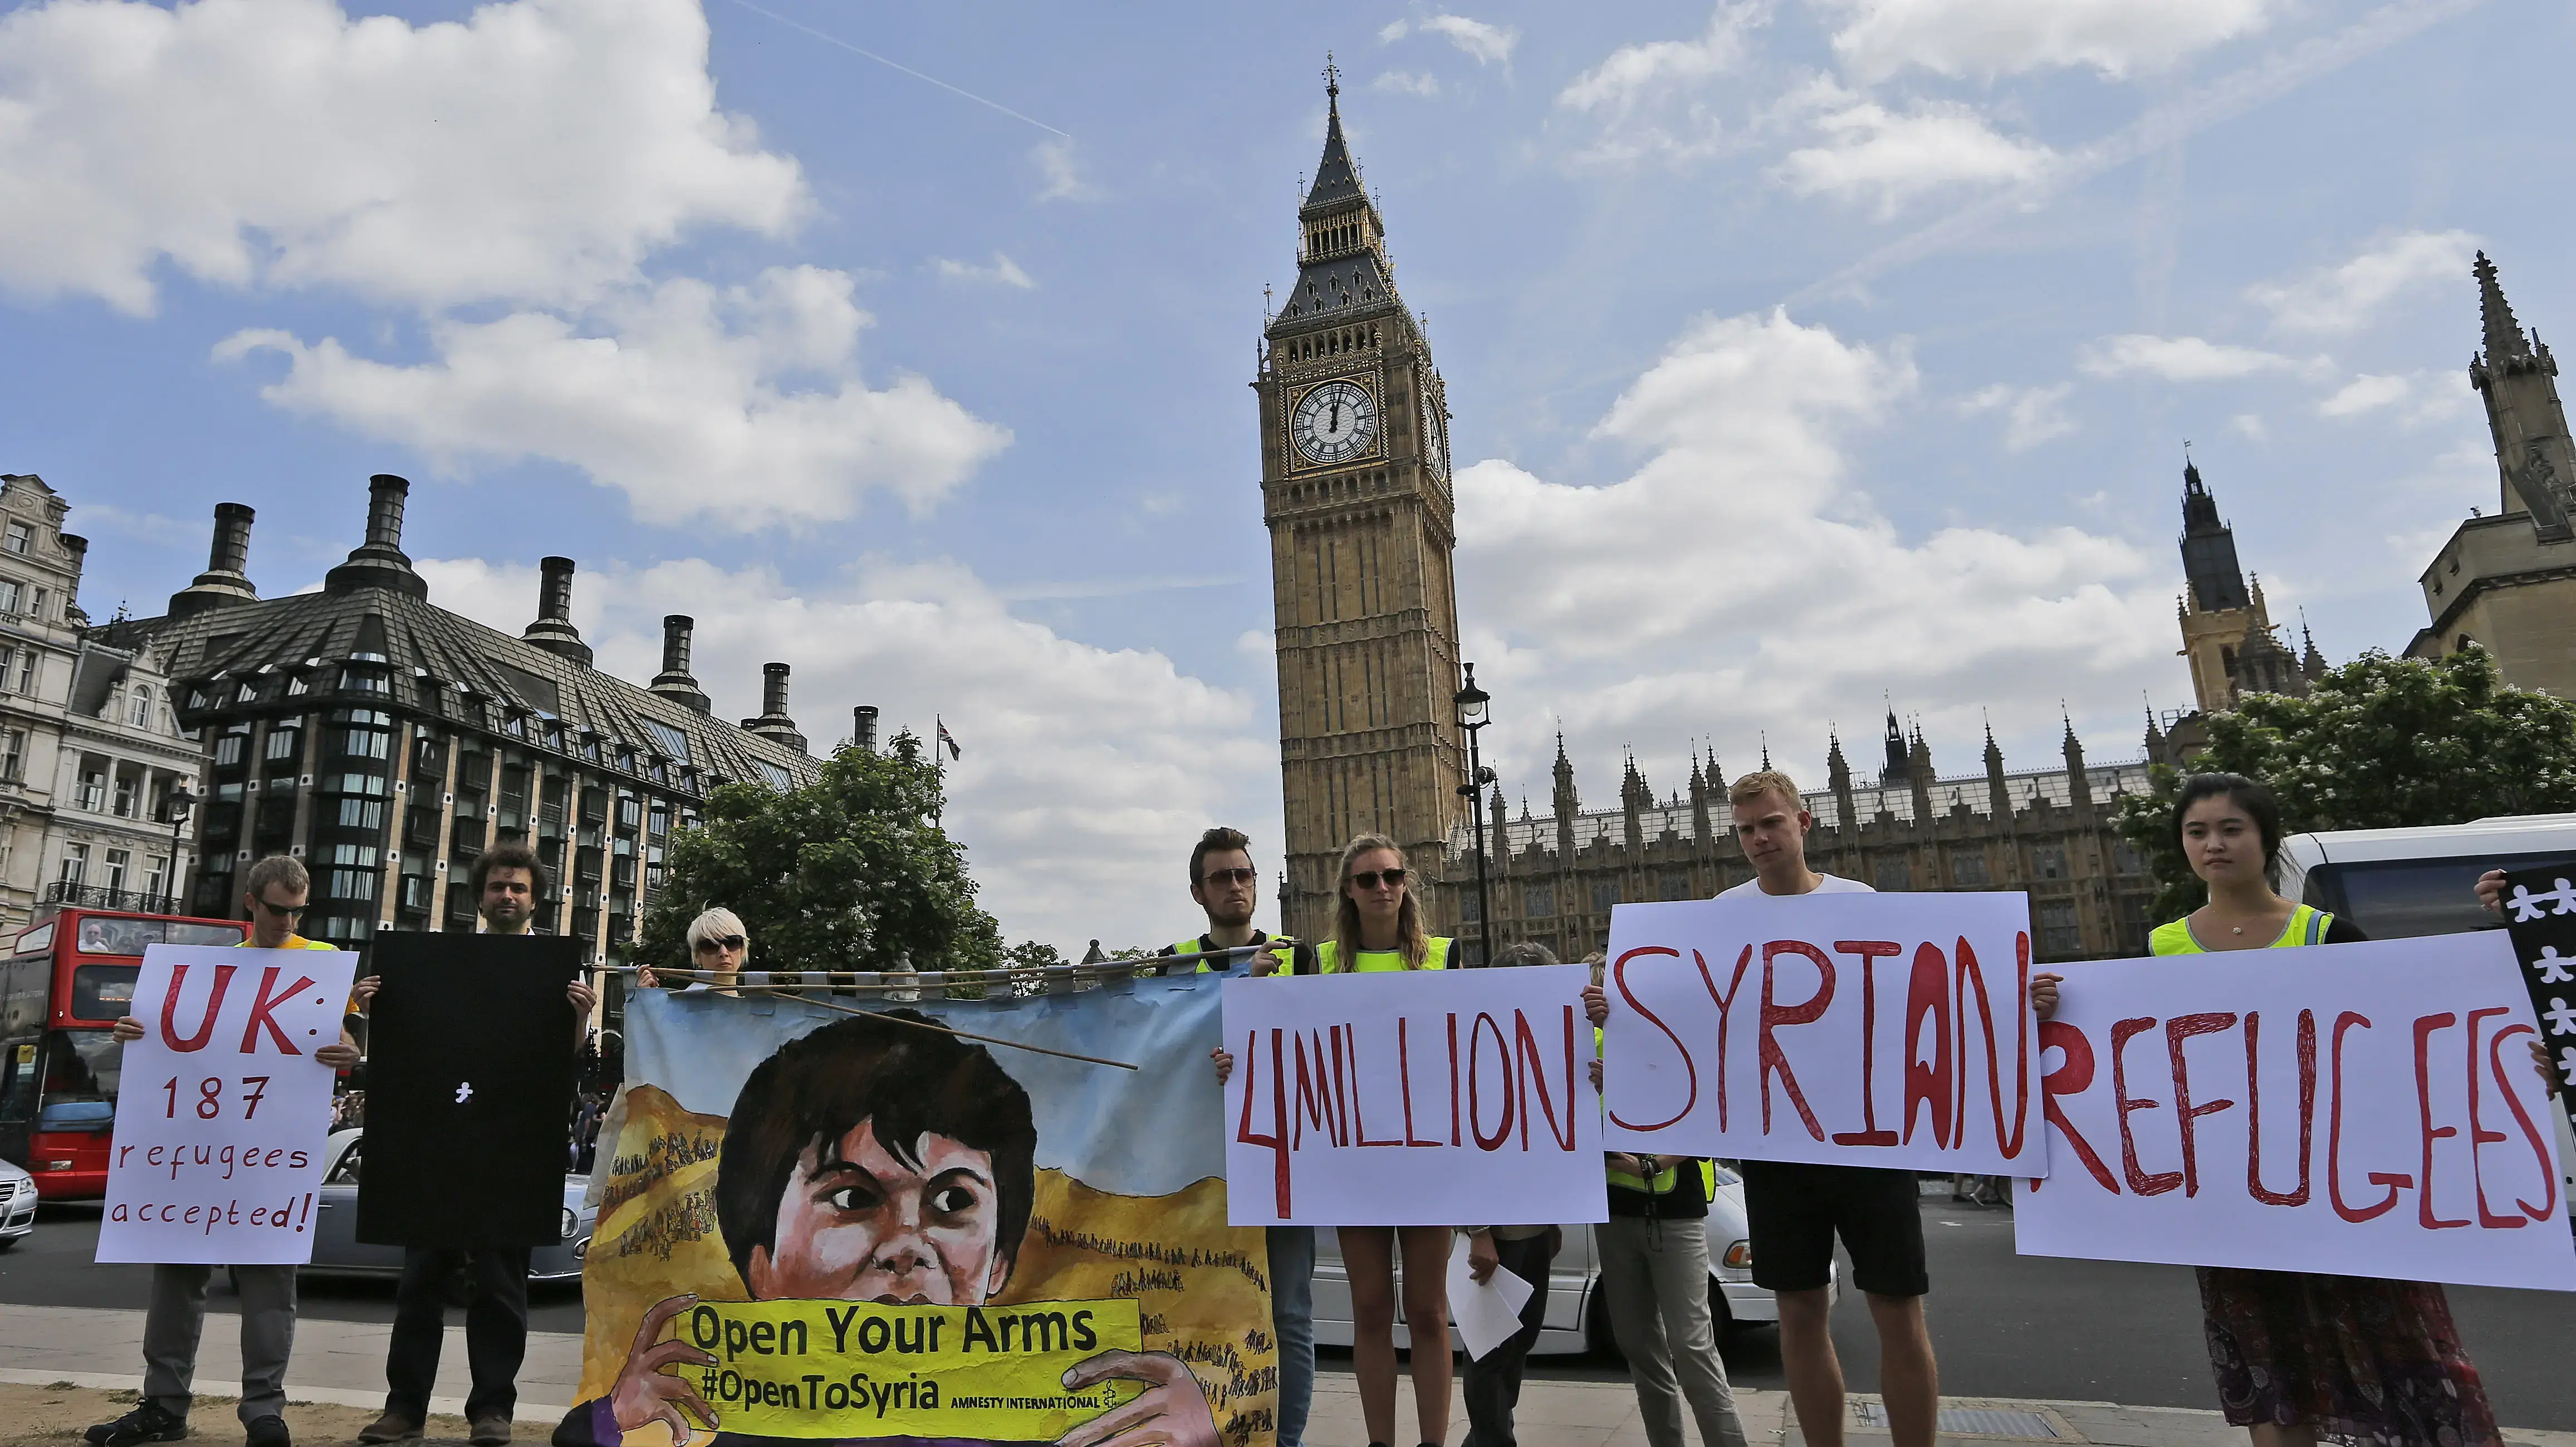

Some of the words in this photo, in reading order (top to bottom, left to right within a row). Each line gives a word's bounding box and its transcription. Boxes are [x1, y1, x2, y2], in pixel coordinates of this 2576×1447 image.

[160, 964, 324, 1055] UK:
[1609, 931, 2029, 1160] SYRIAN
[163, 1076, 270, 1120] 187
[2030, 1008, 2556, 1229] REFUGEES
[118, 1145, 308, 1180] refugees
[111, 1192, 313, 1235] accepted!
[691, 1305, 807, 1362] Open
[825, 1305, 946, 1355] Your
[962, 1306, 1098, 1353] Arms
[701, 1368, 940, 1419] #OpenToSyria
[950, 1396, 1004, 1410] AMNESTY
[1006, 1395, 1100, 1410] INTERNATIONAL
